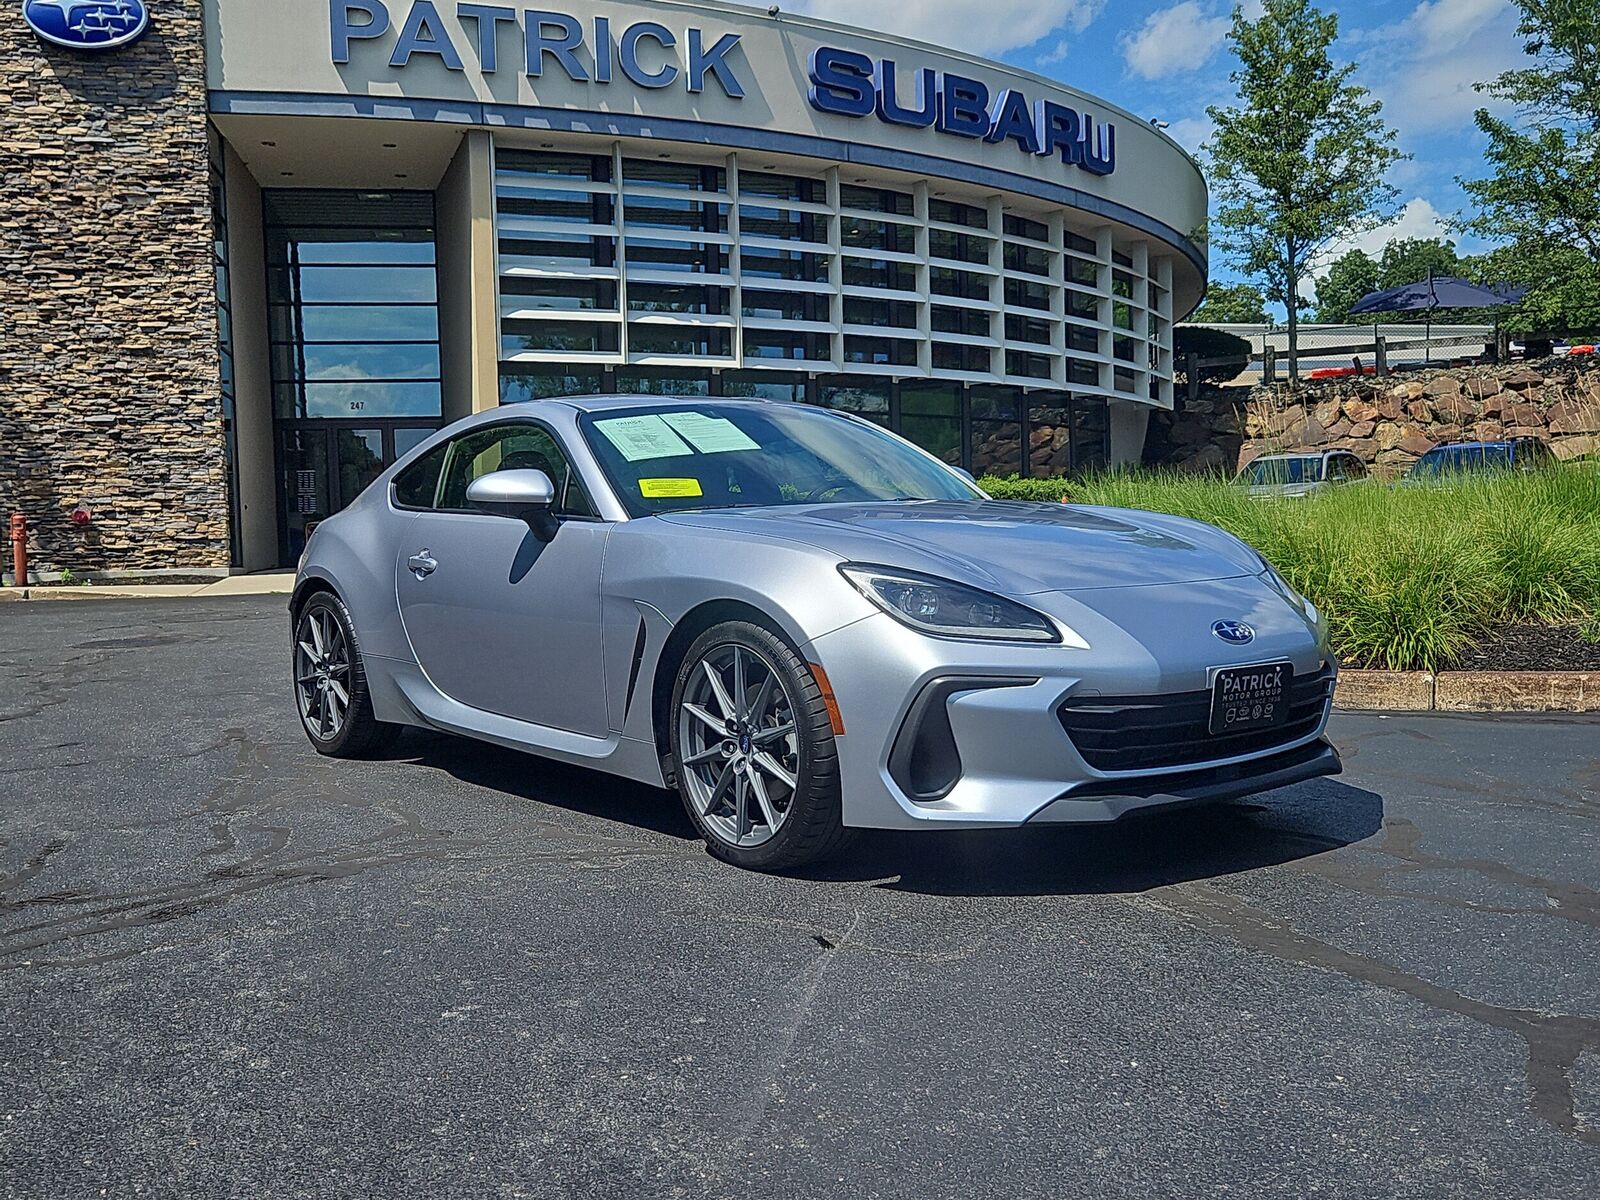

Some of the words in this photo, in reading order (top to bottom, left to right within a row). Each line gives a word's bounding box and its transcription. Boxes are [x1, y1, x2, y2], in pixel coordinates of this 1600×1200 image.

[330, 0, 745, 99] PATRICK
[807, 46, 1116, 177] SUBARU
[350, 401, 364, 410] 247
[1223, 671, 1283, 694] PATRICK
[1222, 691, 1251, 702] MOTOR
[1255, 687, 1282, 697] GROUP
